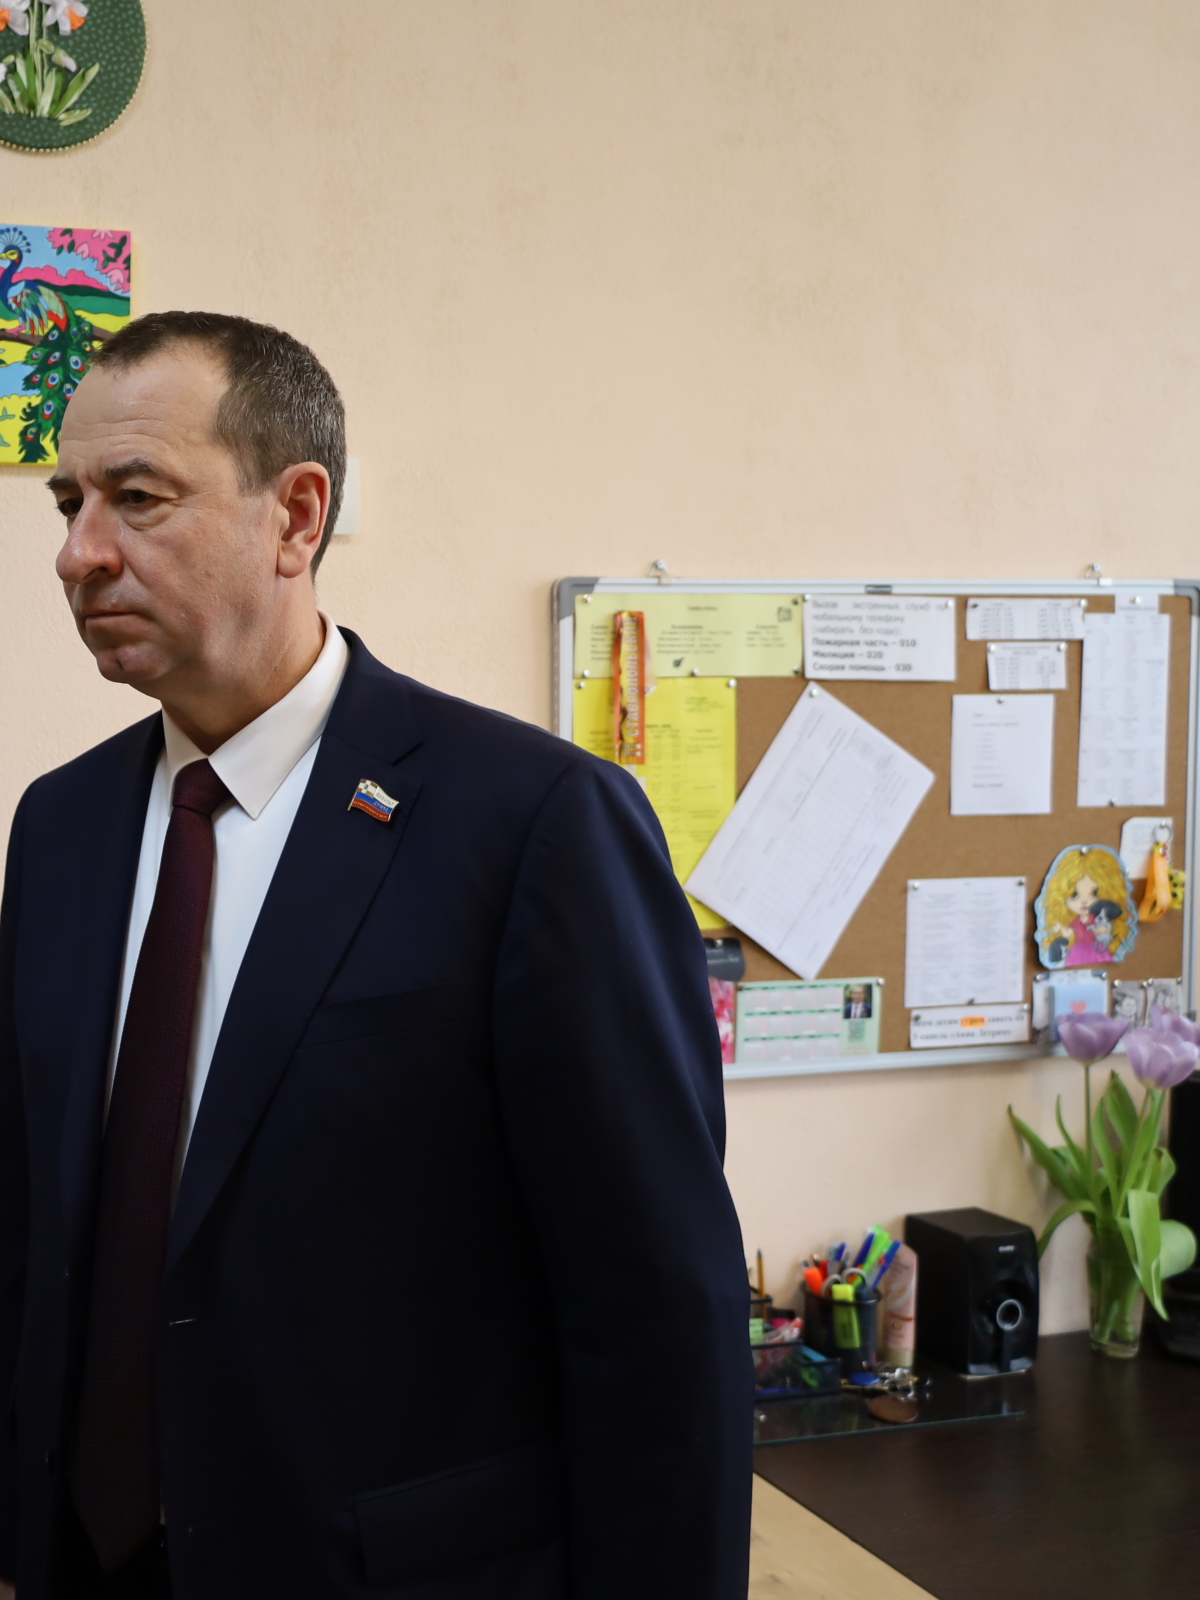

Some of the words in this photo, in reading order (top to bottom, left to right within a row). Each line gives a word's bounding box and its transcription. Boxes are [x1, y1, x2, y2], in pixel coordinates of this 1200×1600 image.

[812, 637, 860, 647] Пожарная
[864, 639, 888, 647] часть
[899, 638, 917, 647] 010
[812, 650, 855, 660] Милиция
[866, 650, 883, 659] 020
[813, 662, 845, 672] Скорая
[894, 663, 912, 672] 030
